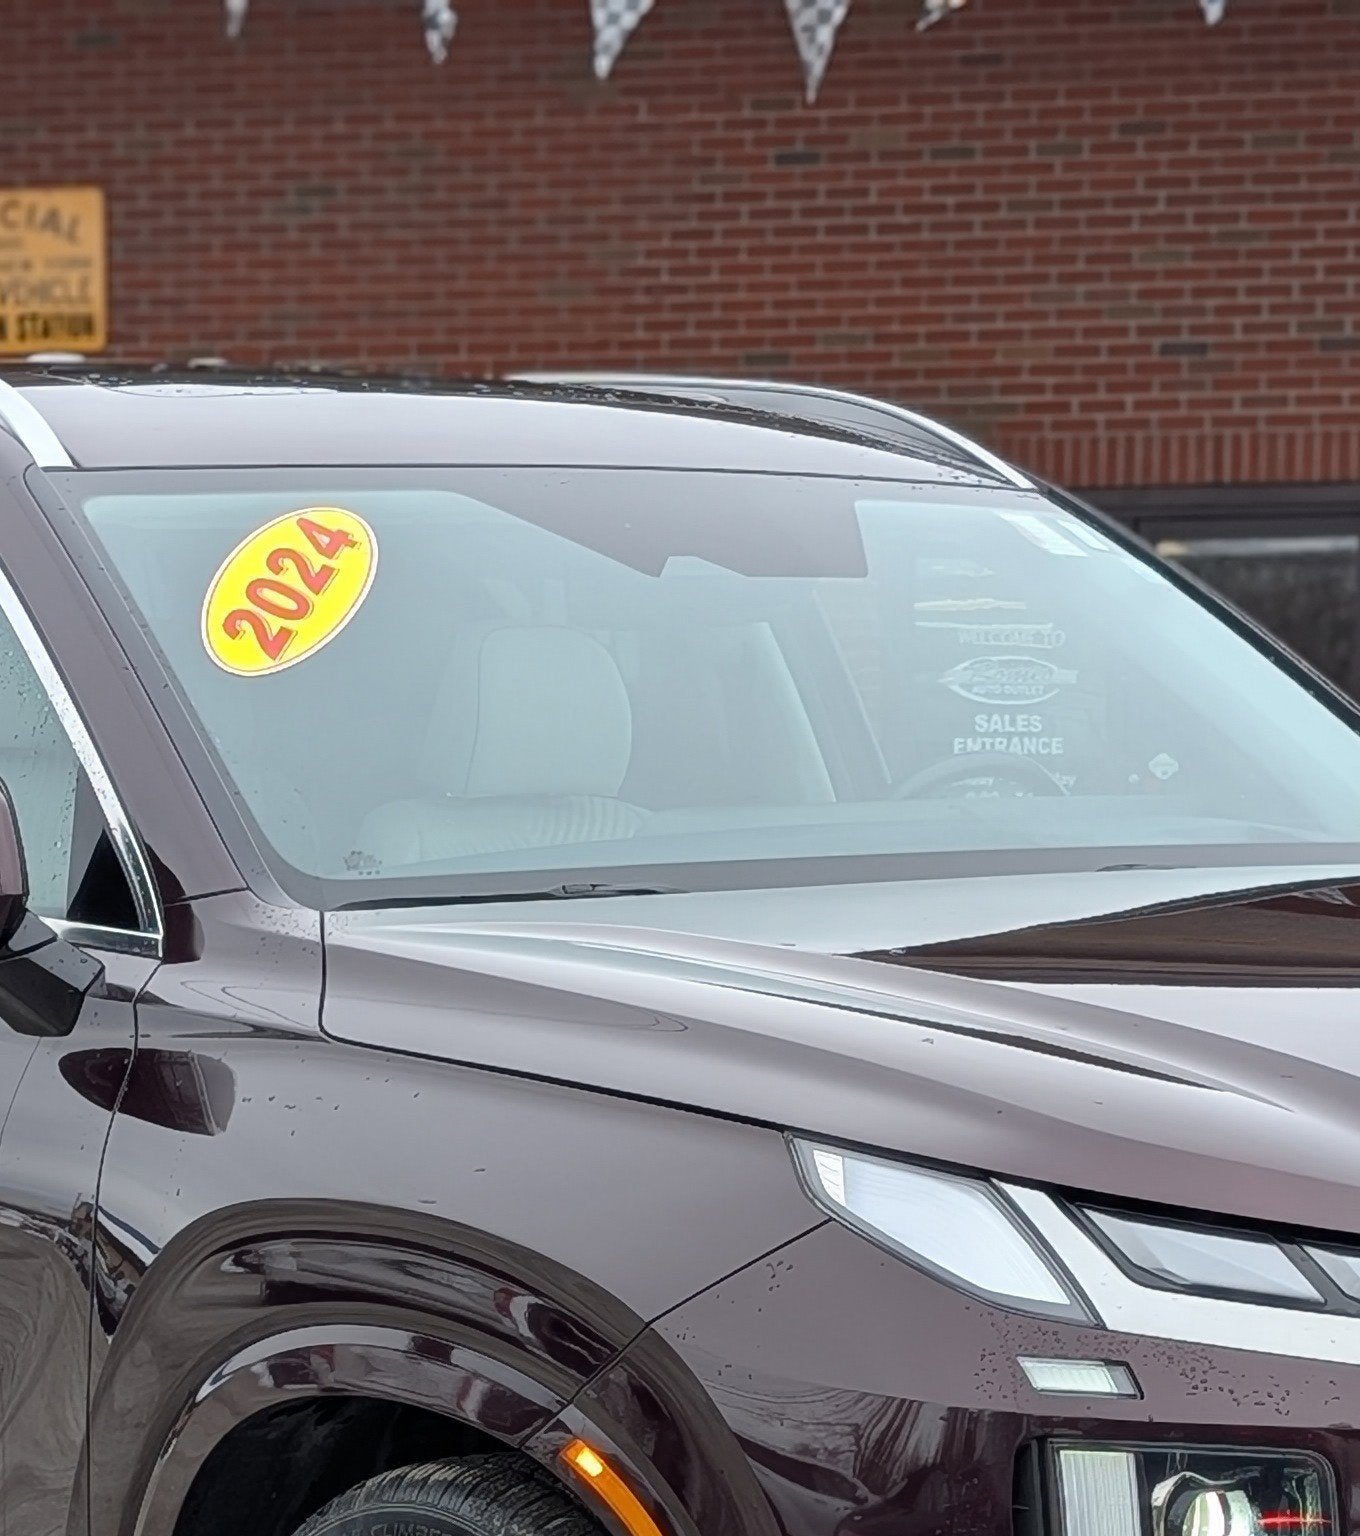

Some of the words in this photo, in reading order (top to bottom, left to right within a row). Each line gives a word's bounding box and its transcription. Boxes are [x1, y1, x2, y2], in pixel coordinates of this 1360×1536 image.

[222, 517, 362, 662] 2024
[974, 713, 1042, 733] SALES
[953, 737, 1064, 755] ENTRANCE
